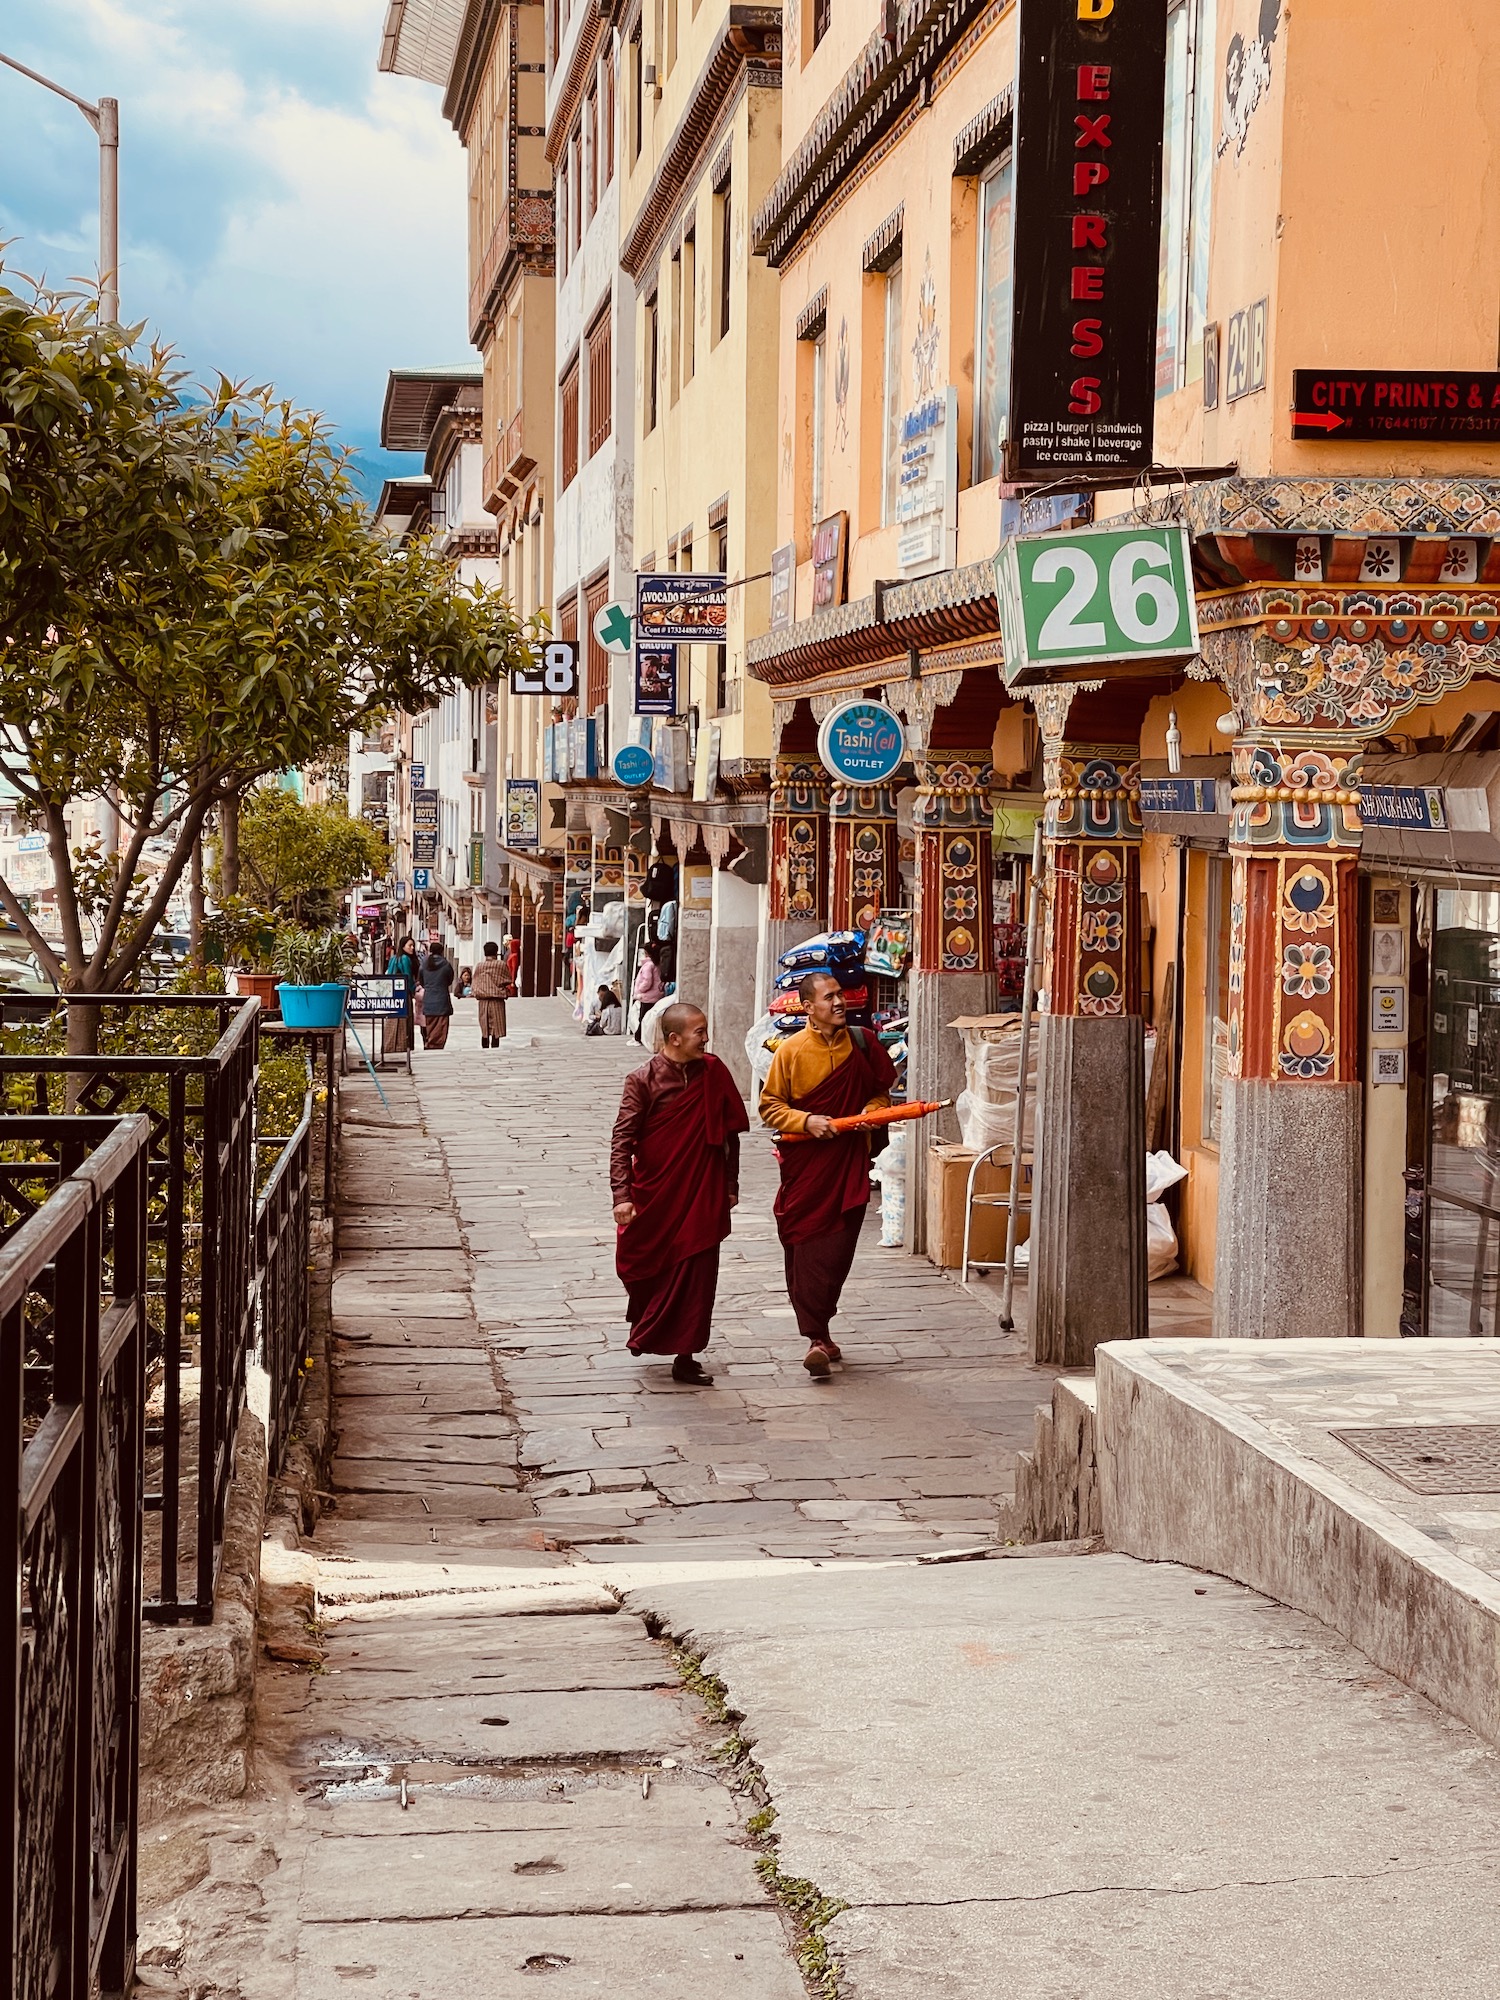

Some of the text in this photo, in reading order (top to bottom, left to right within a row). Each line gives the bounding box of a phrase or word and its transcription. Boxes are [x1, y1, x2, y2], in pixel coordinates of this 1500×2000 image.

[1067, 65, 1112, 415] EXPRESS
[1312, 381, 1367, 407] CITY
[1374, 382, 1459, 408] PRINTS
[1467, 384, 1482, 408] &
[1023, 421, 1049, 434] pizza
[1056, 421, 1089, 435] burger
[1096, 422, 1142, 434] sandwich
[1022, 436, 1054, 448] pastry
[1061, 436, 1090, 447] shake
[1098, 437, 1142, 451] beverage
[1036, 449, 1128, 462] ice cream & more...
[641, 591, 679, 603] AVOCADO
[1032, 540, 1180, 651] 26
[644, 625, 661, 634] Cont
[843, 758, 885, 769] OUTLET
[623, 772, 646, 780] OUTLET
[415, 808, 437, 818] HOTEL
[366, 998, 405, 1009] PHARMACY
